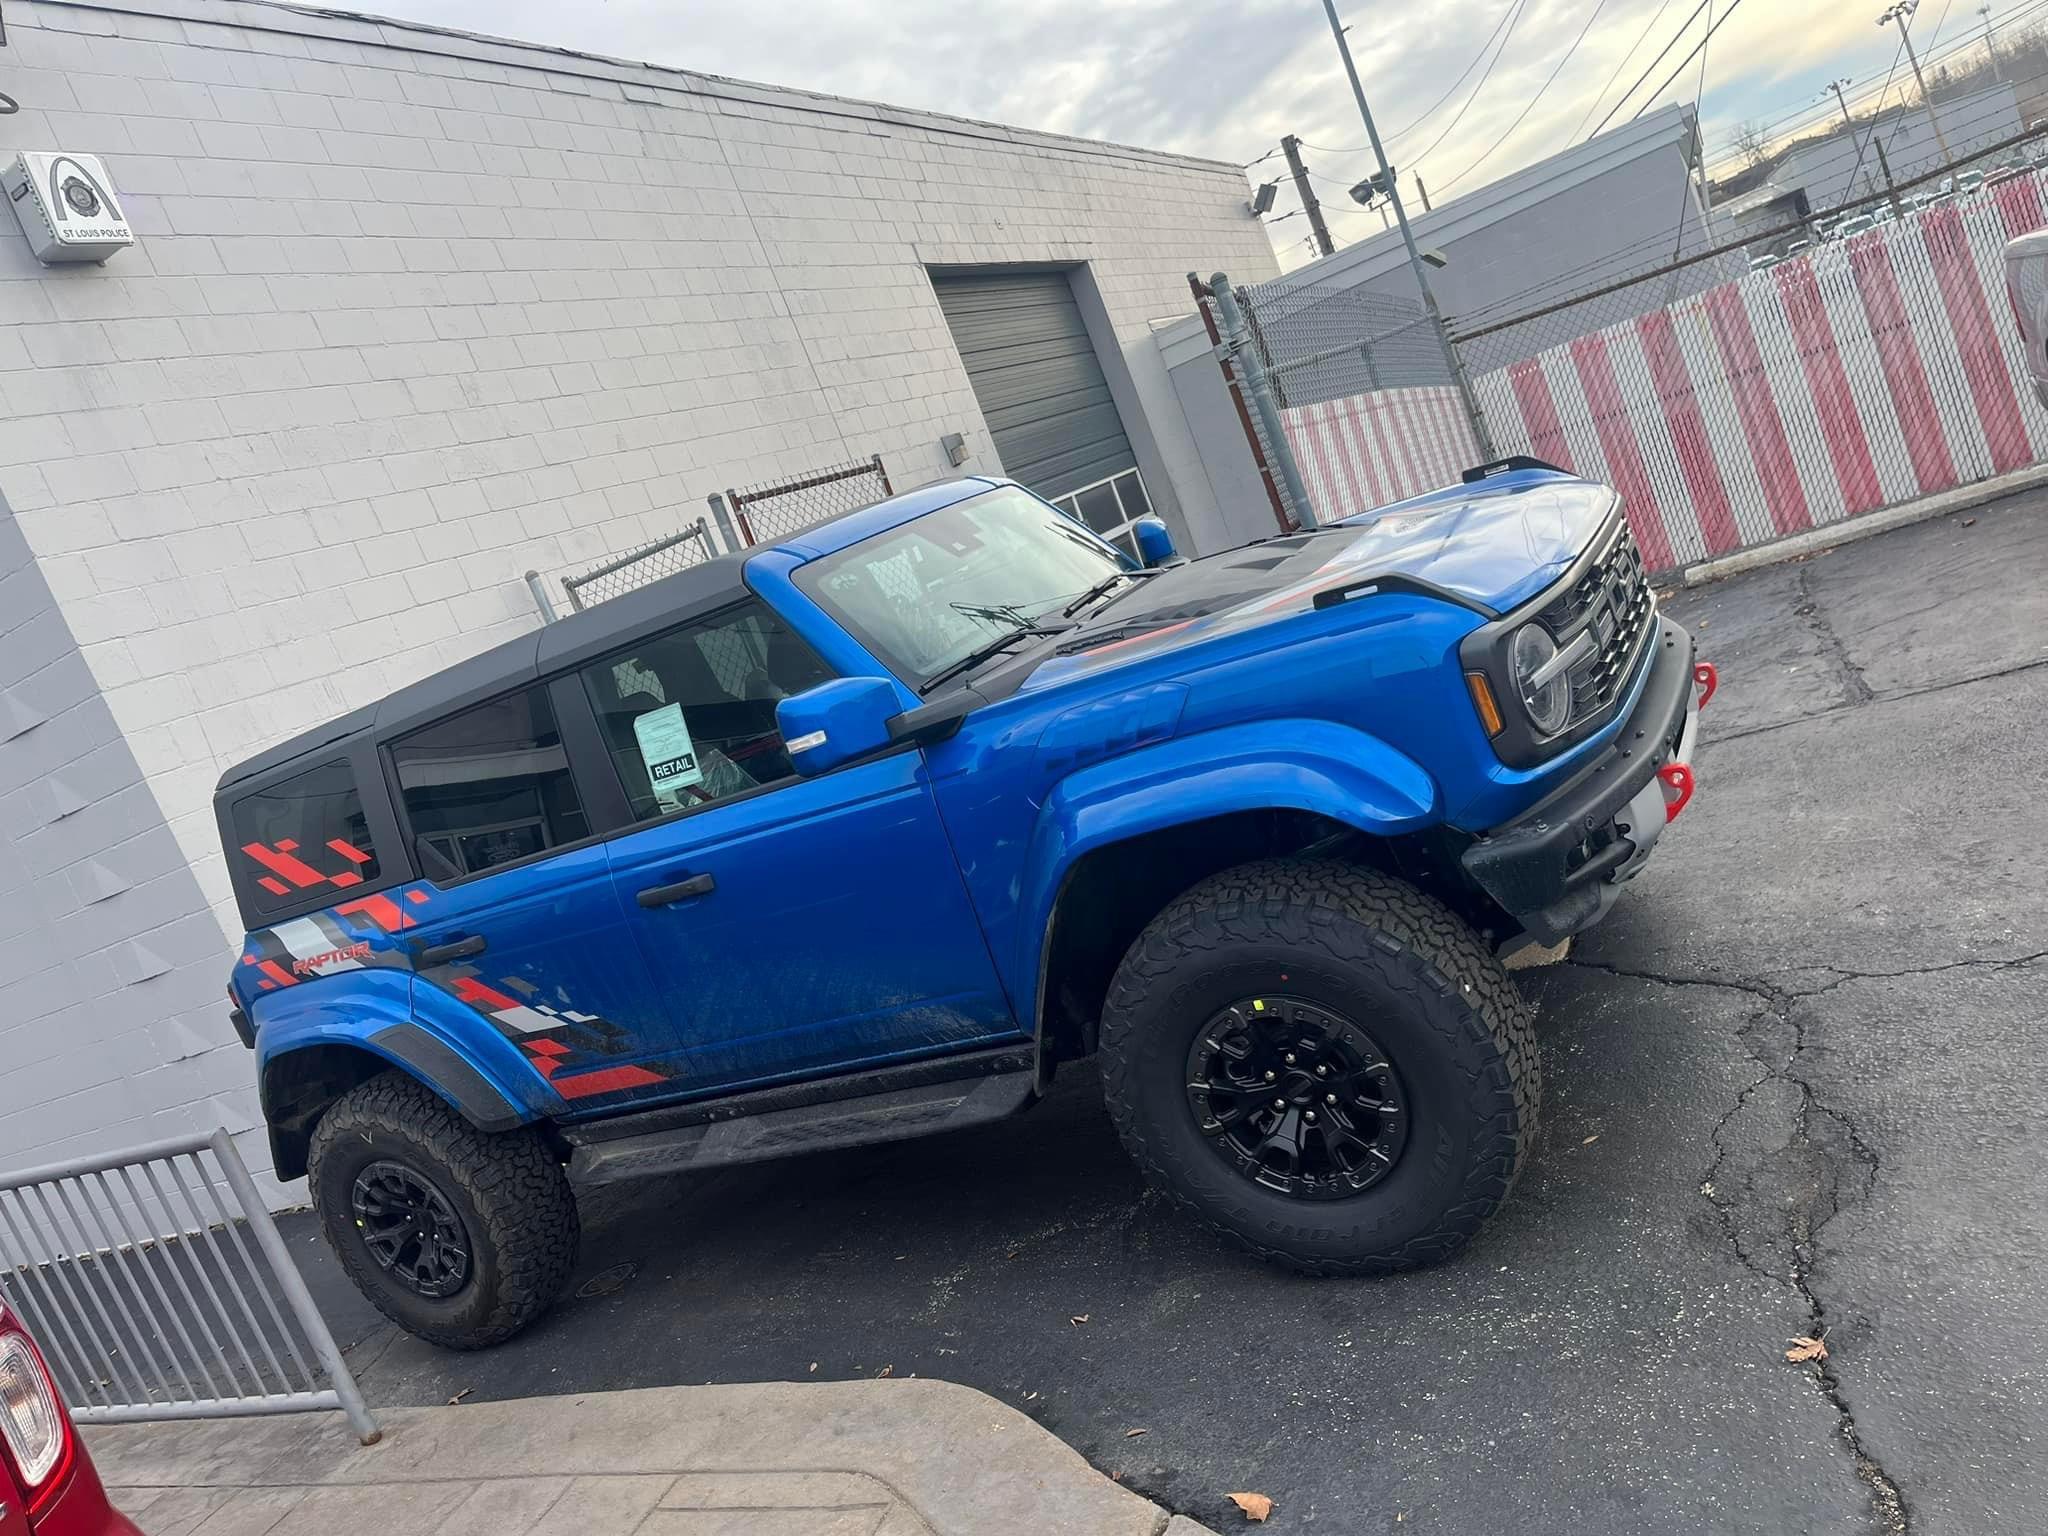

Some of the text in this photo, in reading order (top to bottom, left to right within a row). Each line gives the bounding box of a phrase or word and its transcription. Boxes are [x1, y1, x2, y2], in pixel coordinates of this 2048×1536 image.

[63, 229, 129, 238] ST LOUIS POLICE
[654, 757, 693, 779] RETAIL
[292, 941, 375, 977] RAPTOR
